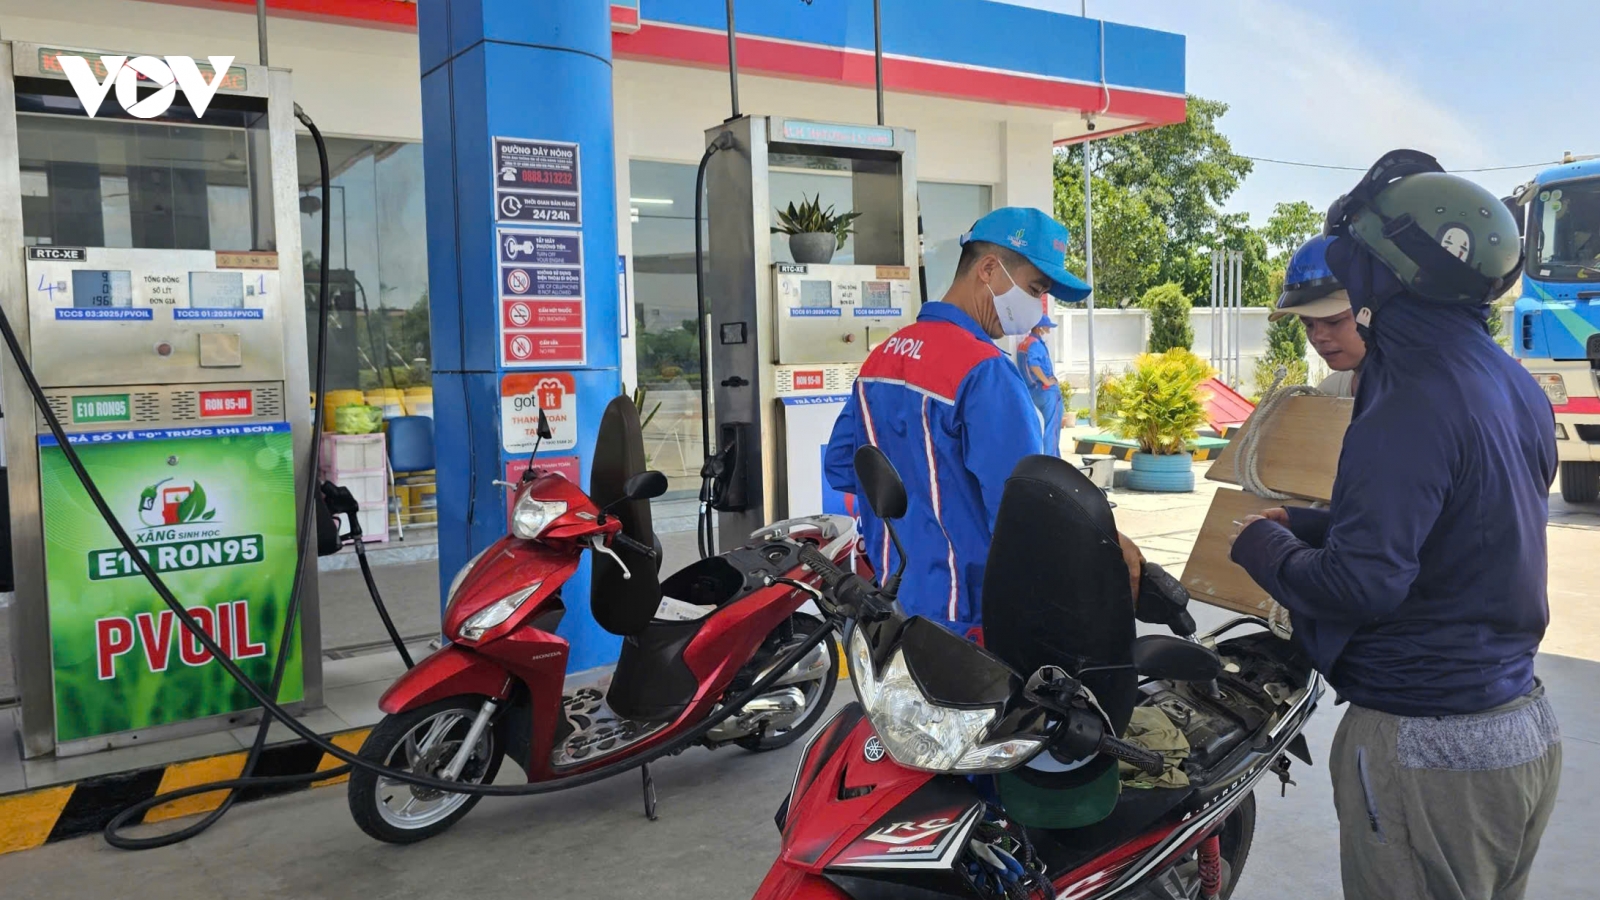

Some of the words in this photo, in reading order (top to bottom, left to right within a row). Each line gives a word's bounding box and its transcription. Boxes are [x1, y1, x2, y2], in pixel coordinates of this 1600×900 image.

[532, 146, 548, 155] DÂY
[550, 148, 573, 158] NÓNG
[533, 209, 570, 220] 24/24h
[36, 250, 79, 259] RTC-XE
[883, 337, 924, 360] PVOIL
[77, 403, 94, 417] E10
[96, 400, 126, 416] RON95
[205, 399, 223, 410] RON
[226, 397, 247, 410] 95-III
[514, 394, 536, 411] got
[546, 393, 556, 407] it
[92, 432, 113, 441] SỐ
[117, 430, 134, 440] VỀ
[166, 427, 213, 438] TRƯỚC
[243, 425, 274, 433] BƠM
[135, 529, 176, 543] XĂNG
[178, 531, 199, 539] SINH
[158, 538, 258, 570] RON95
[95, 600, 266, 680] PVOIL
[532, 651, 562, 660] HONDA
